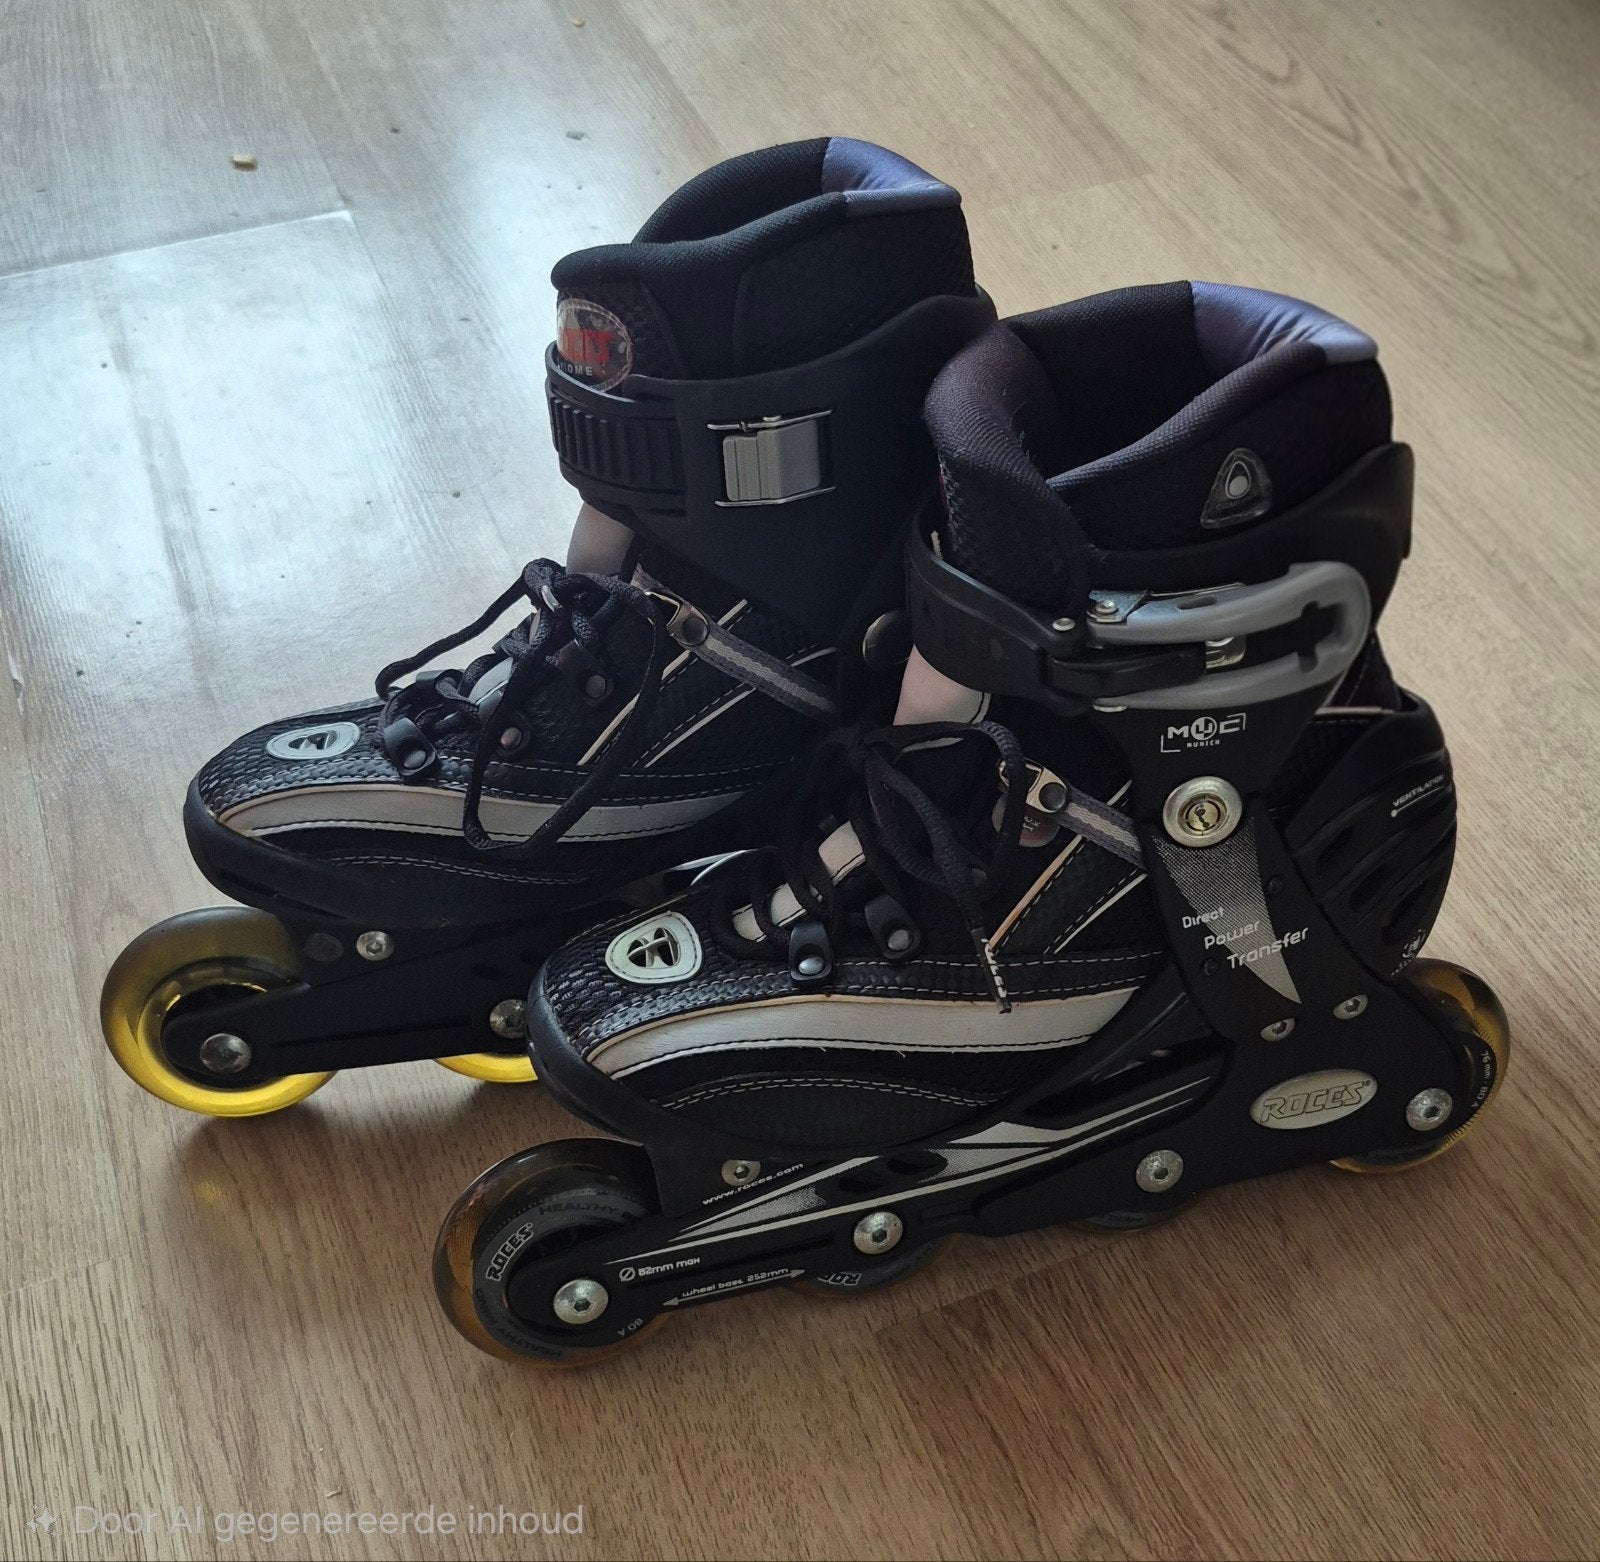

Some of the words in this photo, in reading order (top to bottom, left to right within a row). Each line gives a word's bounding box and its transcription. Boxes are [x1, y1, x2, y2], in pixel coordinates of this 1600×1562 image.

[1181, 906, 1225, 929] Direct
[1204, 921, 1260, 950] Power
[1227, 927, 1309, 970] Transfer
[1260, 1081, 1364, 1123] ROCES
[702, 1163, 804, 1205] www.roces.com
[638, 1263, 674, 1277] 82mm
[676, 1257, 700, 1269] max
[682, 1284, 716, 1298] wheel
[747, 1267, 789, 1283] 252mm
